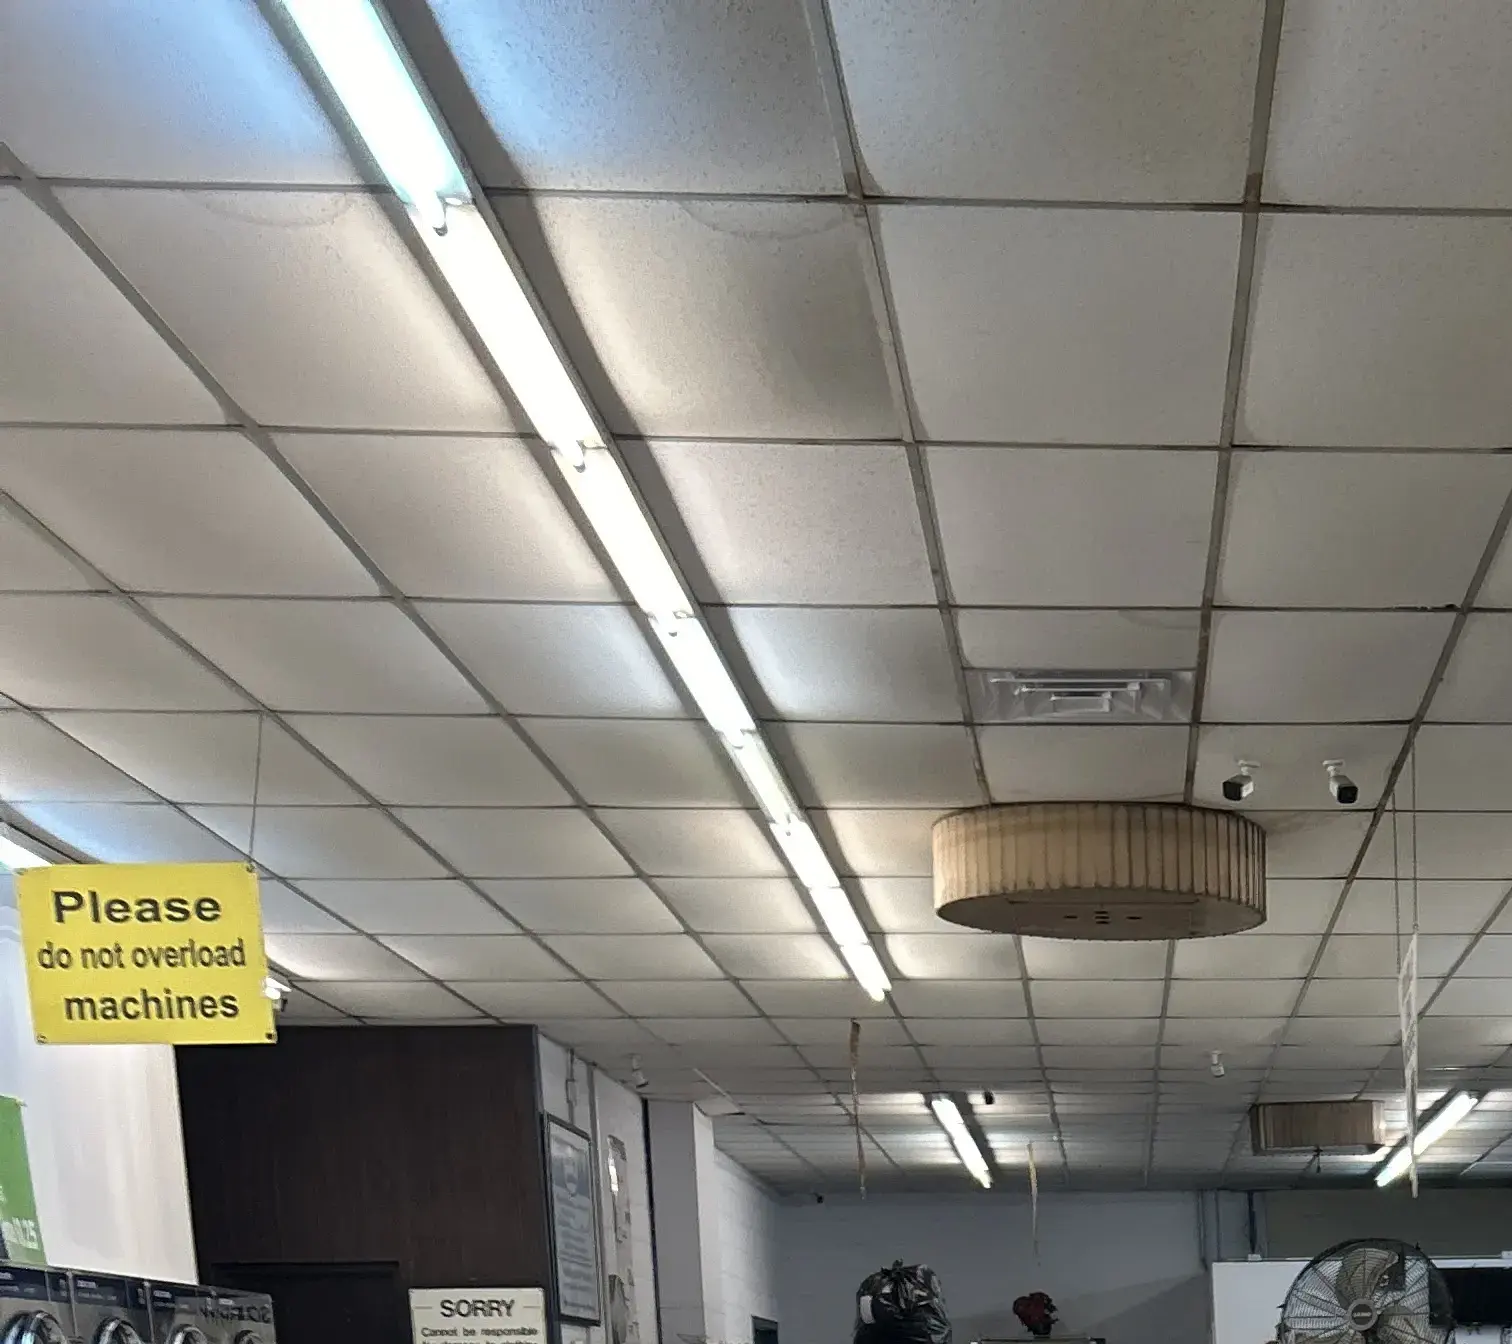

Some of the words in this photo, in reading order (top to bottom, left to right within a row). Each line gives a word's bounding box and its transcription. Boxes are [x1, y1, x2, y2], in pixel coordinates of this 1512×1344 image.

[53, 890, 221, 923] Please
[38, 942, 71, 969] do
[81, 942, 124, 969] not
[132, 938, 246, 968] overload
[64, 988, 239, 1021] machines
[440, 1299, 515, 1318] SORRY
[421, 1327, 458, 1337] Cannot
[463, 1327, 476, 1337] be
[481, 1327, 538, 1338] responsible
